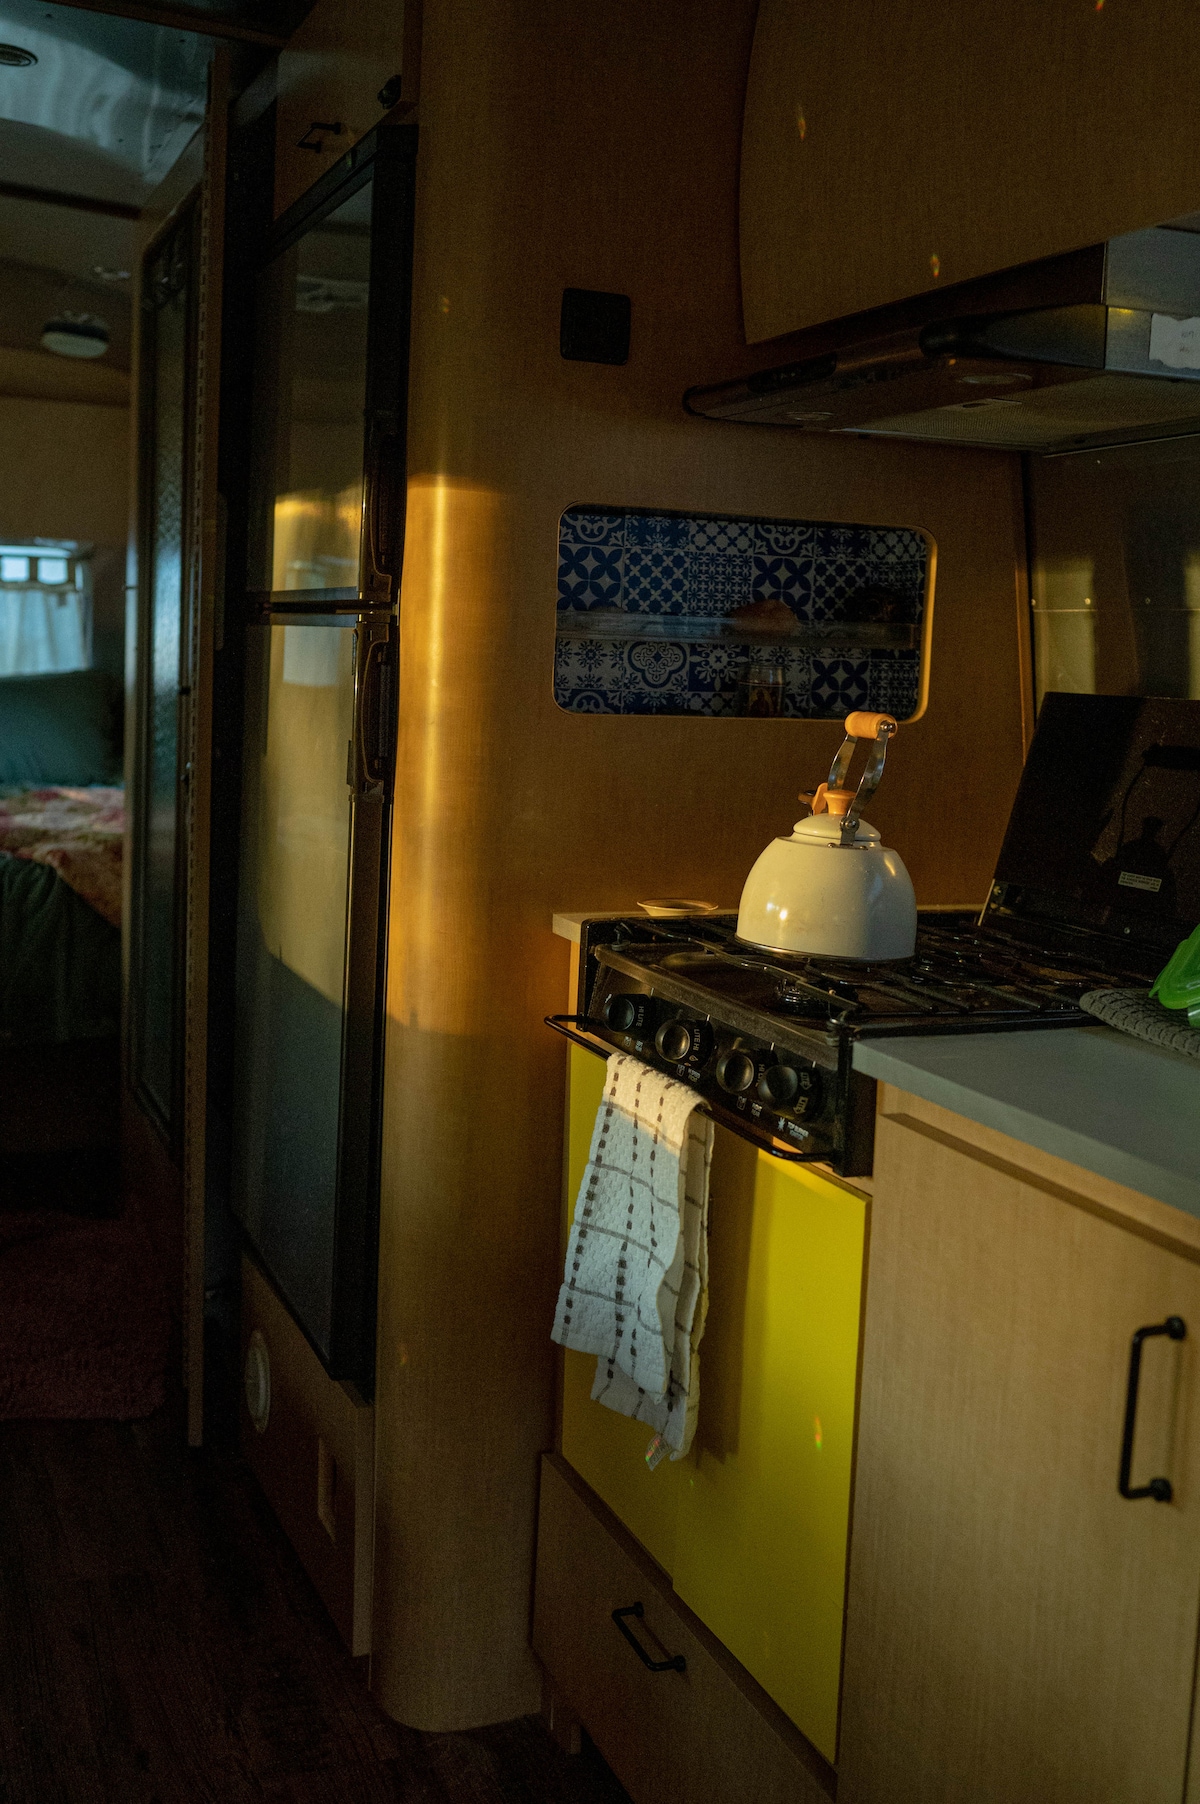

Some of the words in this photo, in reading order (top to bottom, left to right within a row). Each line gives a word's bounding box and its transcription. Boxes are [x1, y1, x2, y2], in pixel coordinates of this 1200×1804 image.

[638, 1005, 645, 1013] HI
[636, 1013, 644, 1027] LITE
[693, 1028, 701, 1043] LITE
[692, 1043, 700, 1051] HI
[758, 1063, 766, 1072] HI
